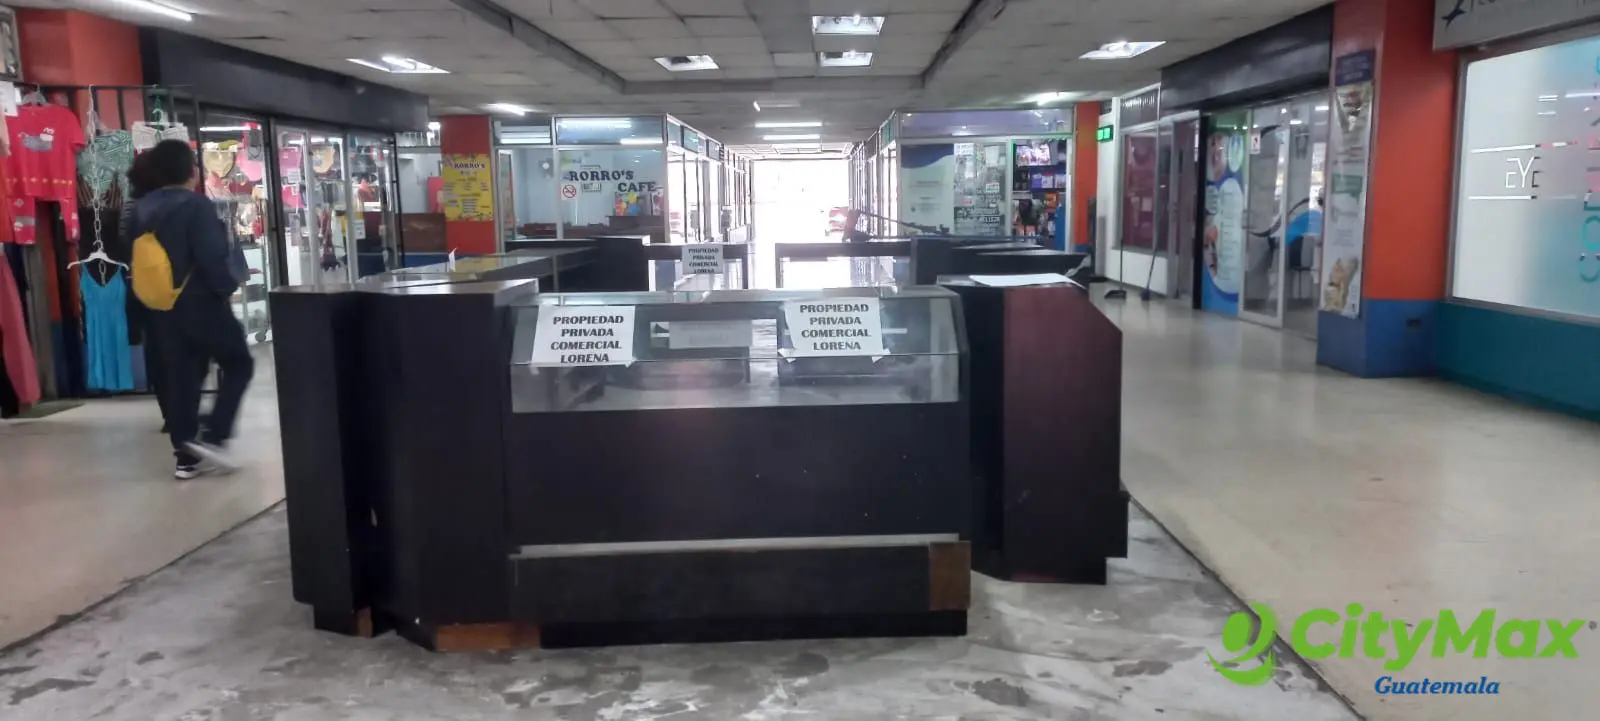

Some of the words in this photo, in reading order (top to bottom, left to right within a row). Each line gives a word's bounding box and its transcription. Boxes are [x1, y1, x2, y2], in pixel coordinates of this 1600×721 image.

[569, 170, 634, 181] RORRO'S
[617, 181, 656, 193] CAFE
[800, 303, 869, 313] PROPIEDAD
[553, 315, 624, 325] PROPIEDAD
[809, 316, 862, 325] PRIVADA
[561, 328, 614, 337] PRIVADA
[801, 329, 871, 338] COMERCIAL
[550, 340, 622, 350] COMERCIAL
[813, 341, 861, 351] LORENA
[560, 353, 609, 364] LORENA
